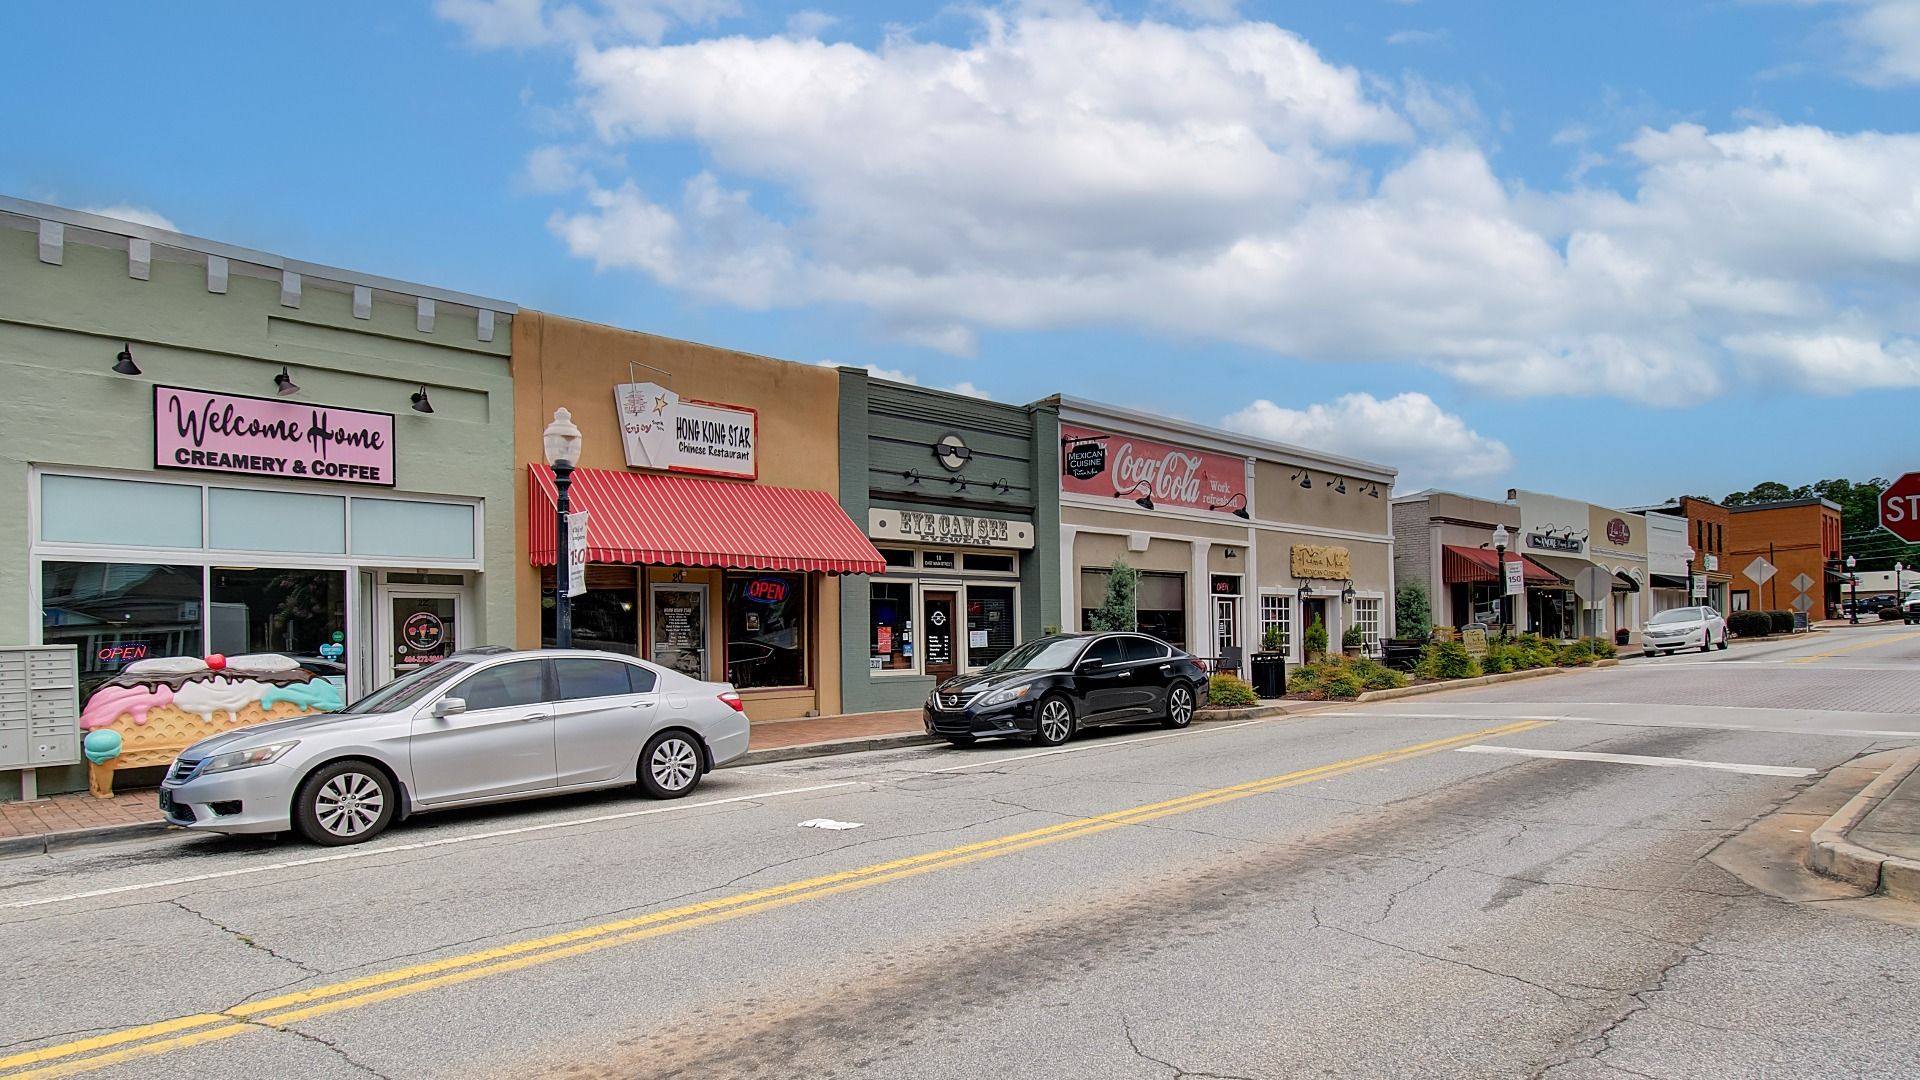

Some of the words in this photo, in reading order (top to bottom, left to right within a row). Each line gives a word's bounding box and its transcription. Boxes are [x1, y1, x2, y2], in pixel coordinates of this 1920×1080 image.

[169, 395, 303, 447] Welcome
[307, 410, 385, 460] Home
[625, 422, 651, 434] Enjoy
[676, 416, 700, 441] HONG
[702, 420, 726, 445] KONG
[728, 424, 751, 448] STAR
[678, 441, 706, 455] Chinese
[708, 445, 750, 460] Restaurant
[1068, 450, 1103, 460] MEXICAN
[175, 448, 287, 473] CREAMERY
[292, 460, 307, 474] &
[311, 460, 380, 480] COFFEE
[1070, 458, 1101, 468] CUISINE
[1111, 443, 1202, 503] Coca-Cola
[1210, 480, 1230, 493] Work
[1886, 494, 1920, 522] ST
[900, 511, 935, 535] EYE
[938, 514, 974, 539] CAN
[978, 518, 1008, 541] SEE
[920, 534, 991, 546] EYEWEAR
[750, 581, 785, 600] OPEN
[1216, 582, 1229, 591] OPEN
[98, 645, 147, 660] OPEN
